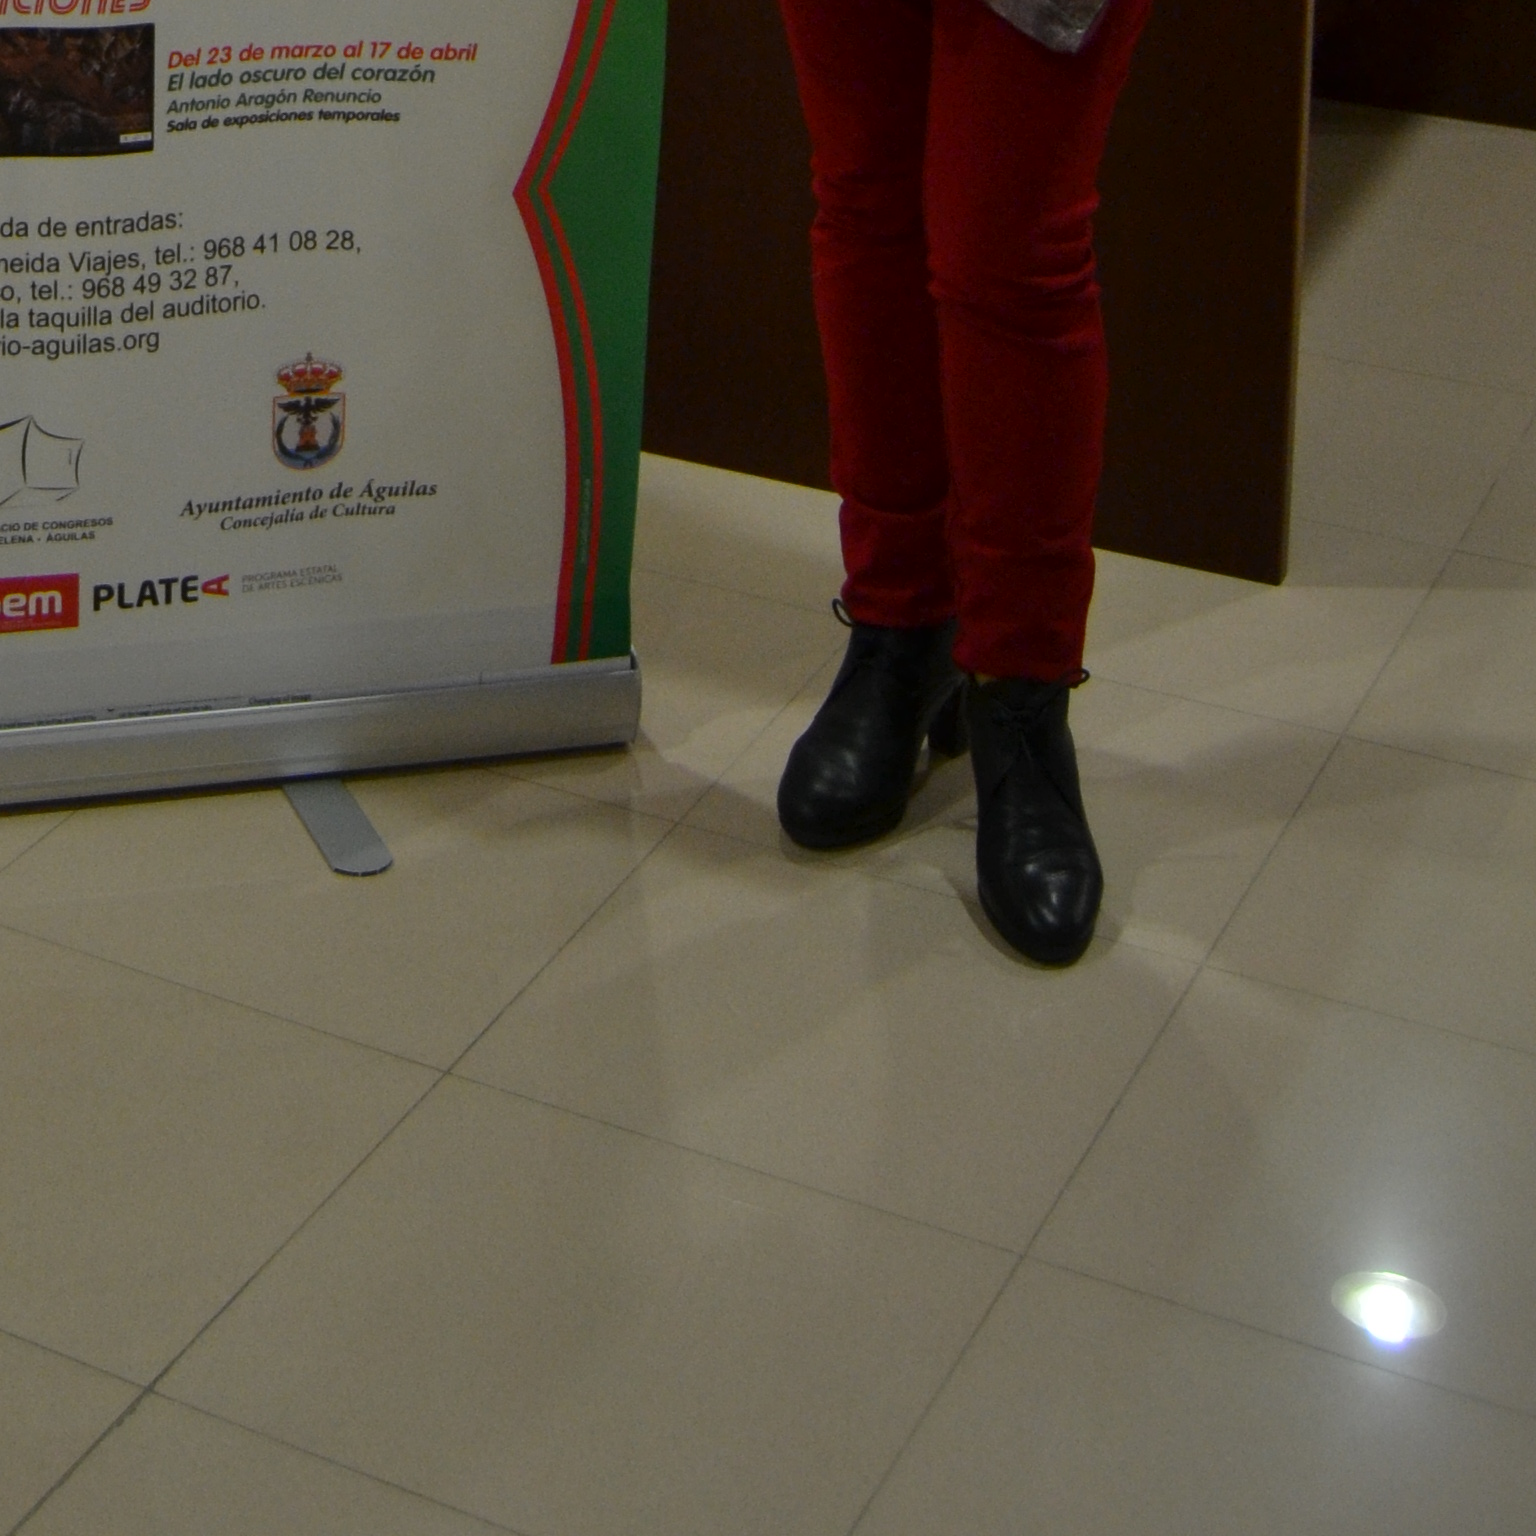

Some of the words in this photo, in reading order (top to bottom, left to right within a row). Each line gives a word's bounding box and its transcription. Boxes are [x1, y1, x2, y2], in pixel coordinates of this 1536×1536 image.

[168, 73, 184, 92] El
[189, 69, 233, 88] lado
[239, 68, 306, 85] oscuro
[313, 63, 345, 81] del
[351, 65, 435, 83] corazón
[167, 95, 231, 114] Antonio
[235, 90, 297, 109] Aragón
[303, 90, 382, 105] Renuncio
[38, 217, 67, 238] de
[75, 212, 182, 237] entradas:
[180, 488, 323, 520] Ayuntamiento
[329, 482, 353, 500] de
[359, 479, 437, 503] Águilas
[220, 506, 304, 531] Concejalía
[309, 505, 327, 520] de
[332, 503, 395, 517] Cultura
